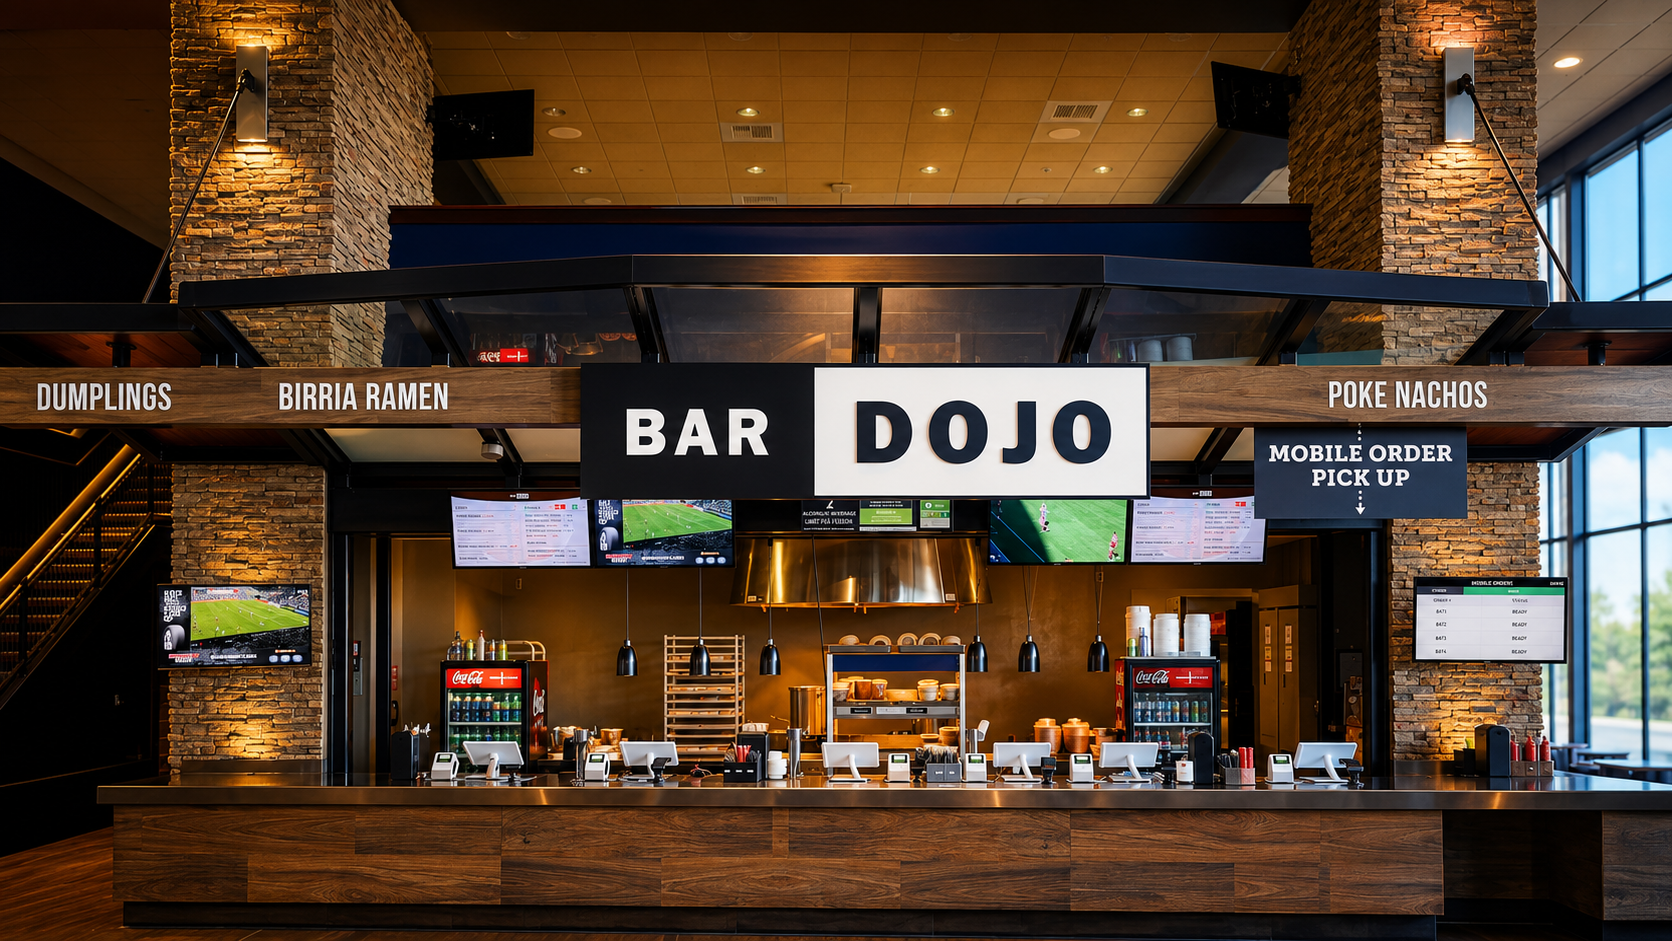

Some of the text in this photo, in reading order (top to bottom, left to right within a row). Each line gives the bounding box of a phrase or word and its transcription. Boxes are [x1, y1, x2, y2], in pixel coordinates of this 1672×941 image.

[37, 382, 172, 411] DUMPLINGS
[279, 382, 449, 411] BIRRIA RAMEN
[1328, 380, 1488, 409] POKE NACHOS
[626, 399, 1112, 465] BAR DOJO
[1268, 444, 1453, 463] MOBILE ORDER
[1311, 468, 1410, 487] PICK UP
